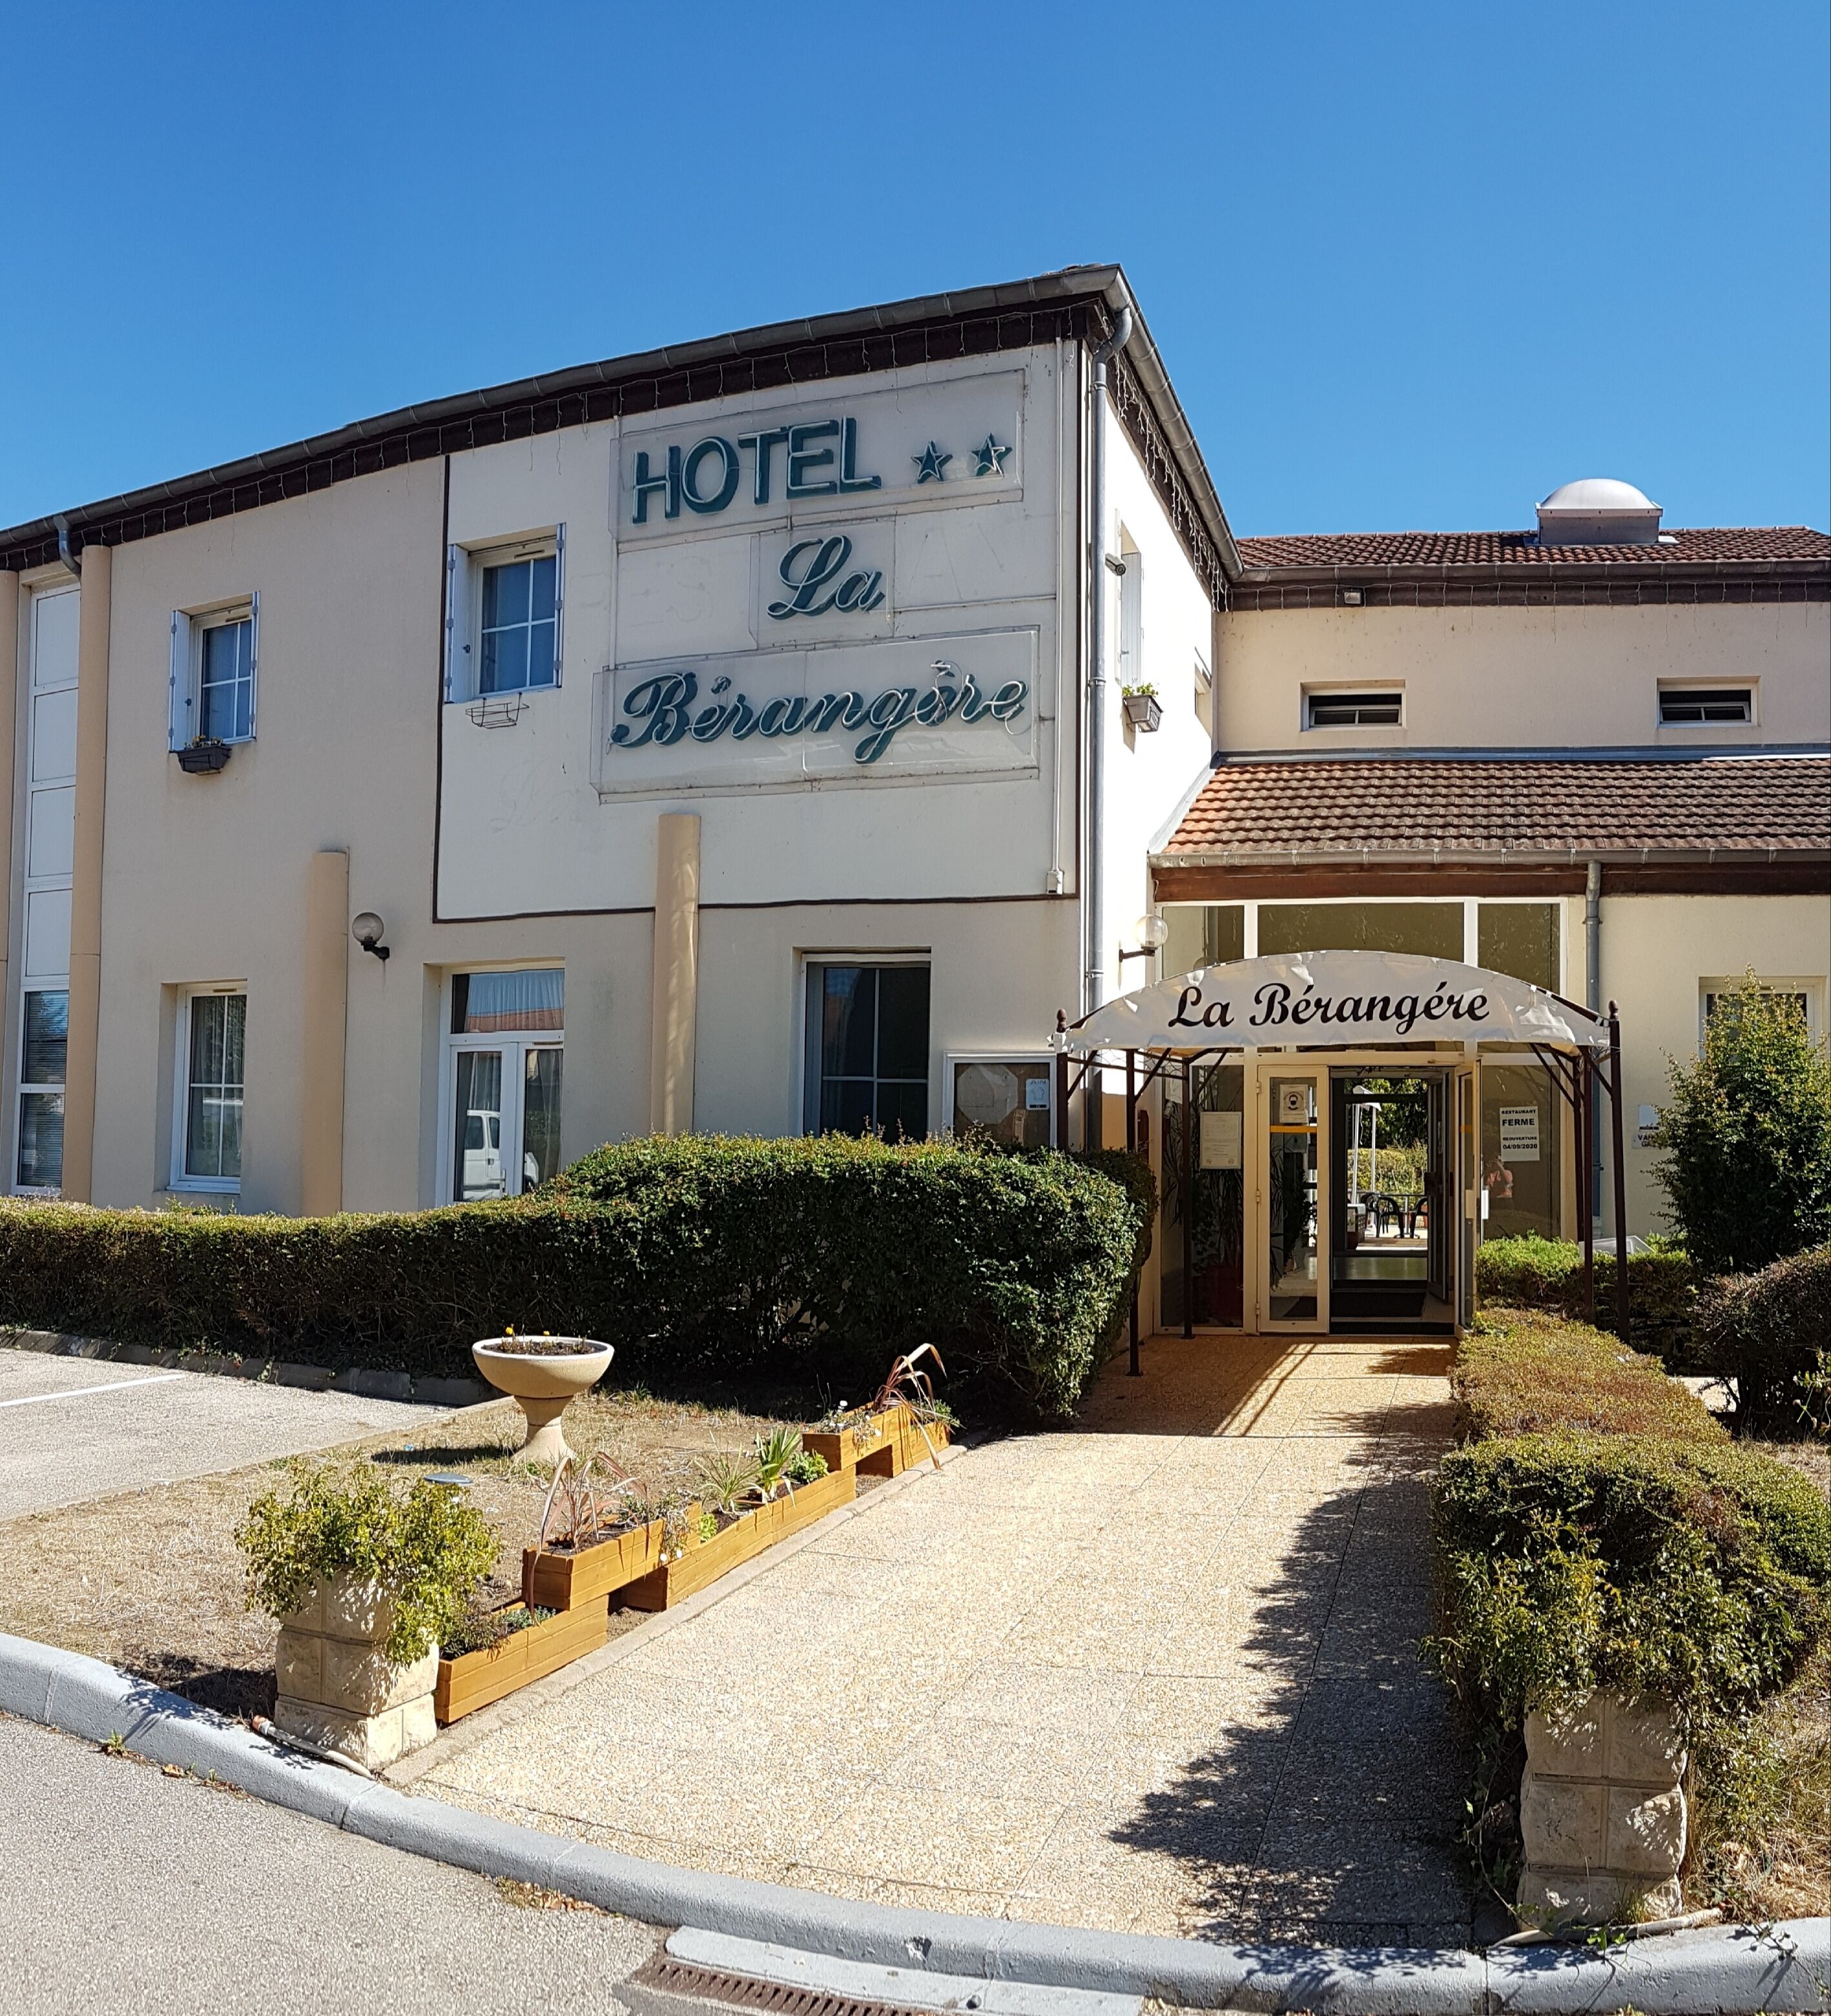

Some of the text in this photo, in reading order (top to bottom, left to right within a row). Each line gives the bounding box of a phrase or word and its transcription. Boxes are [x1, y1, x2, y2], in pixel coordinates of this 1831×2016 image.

[632, 415, 882, 524] HOTEL
[766, 535, 885, 621] La
[610, 660, 1029, 764] Bérangère
[1168, 985, 1234, 1028] La
[1249, 982, 1490, 1034] Bérangére
[1502, 1118, 1535, 1126] FERME
